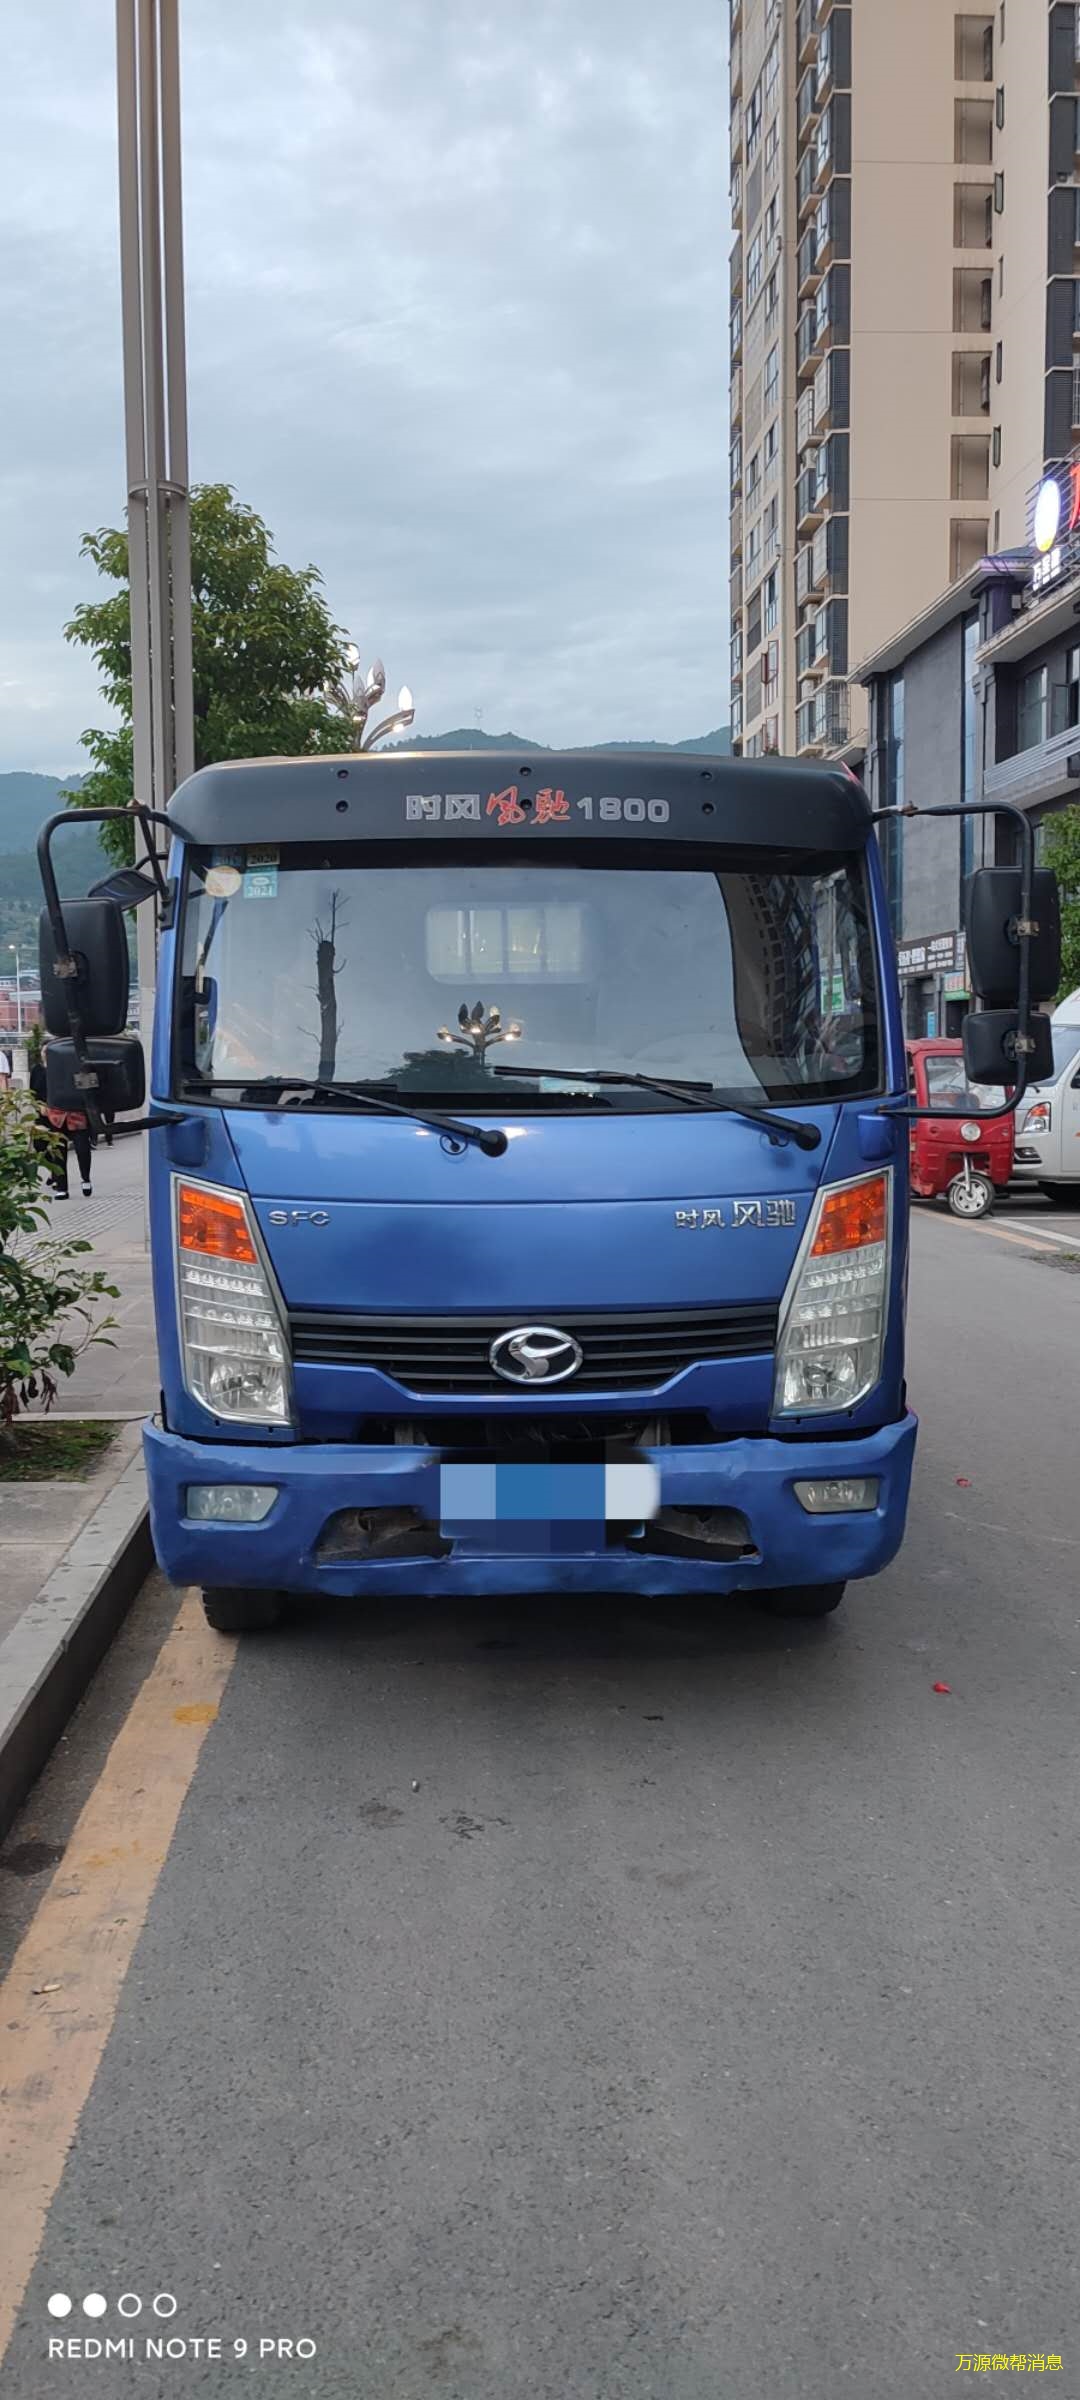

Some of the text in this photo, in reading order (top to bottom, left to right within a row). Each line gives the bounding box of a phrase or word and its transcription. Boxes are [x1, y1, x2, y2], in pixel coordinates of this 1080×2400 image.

[576, 797, 670, 823] 1800
[268, 1210, 329, 1225] SFC
[675, 1199, 796, 1229] 时风 风驰
